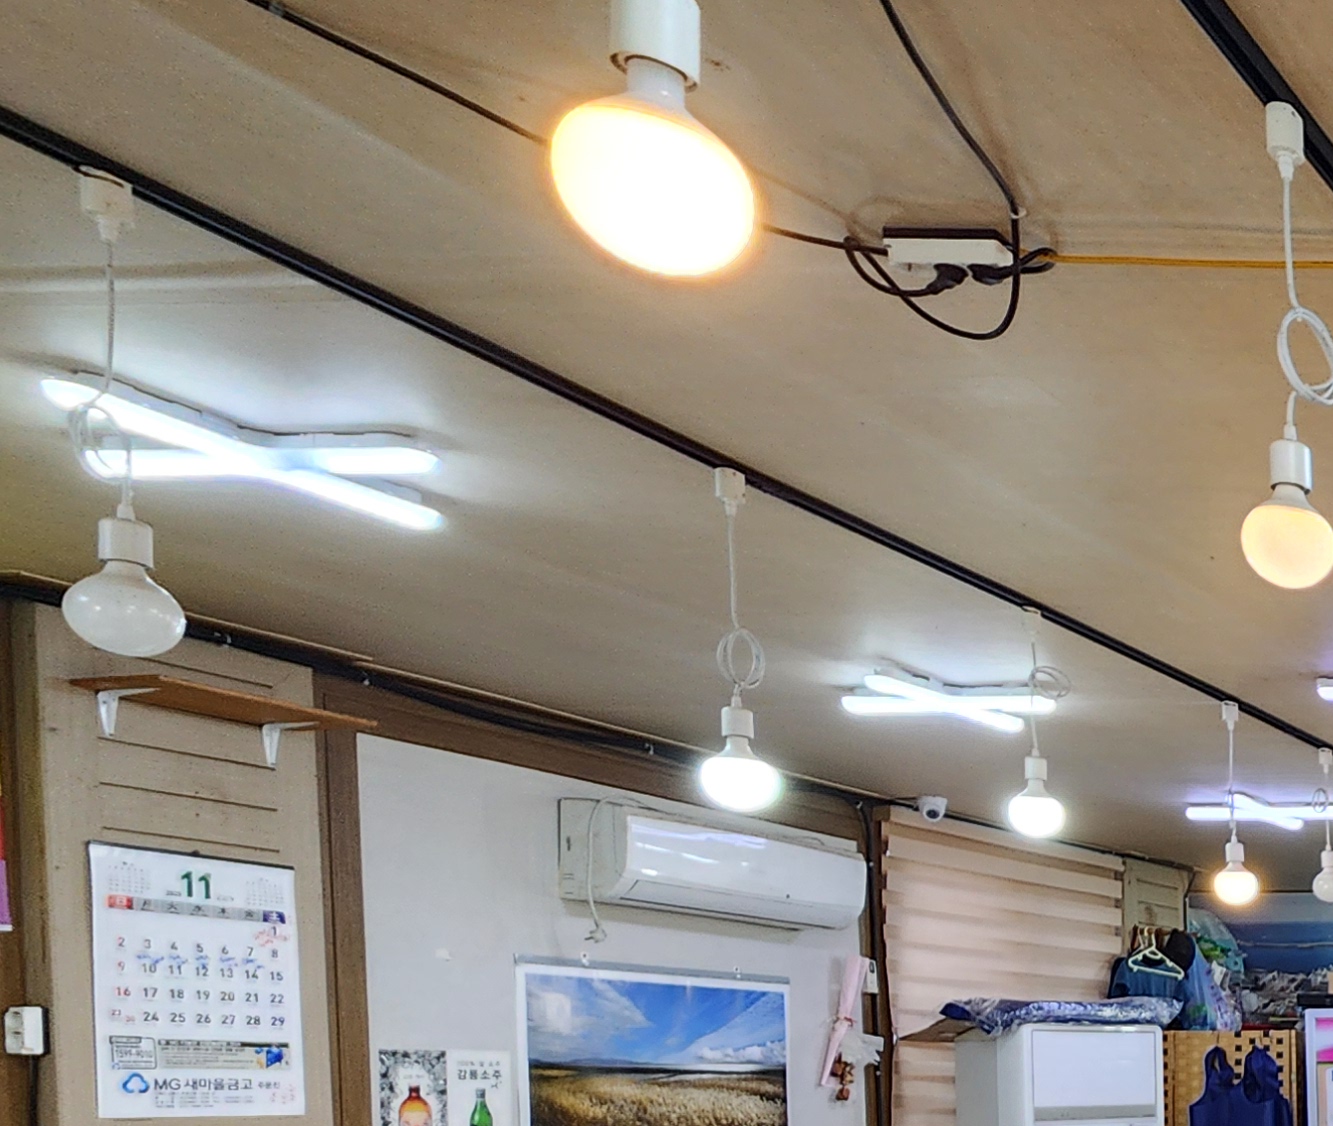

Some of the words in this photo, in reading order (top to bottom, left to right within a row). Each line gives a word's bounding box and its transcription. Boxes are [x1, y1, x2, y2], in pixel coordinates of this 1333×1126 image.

[181, 871, 211, 899] 11
[143, 939, 151, 948] 3
[171, 942, 178, 950] 4
[222, 946, 229, 955] 6
[271, 950, 278, 958] 8
[142, 963, 157, 973] 10
[169, 965, 182, 975] 11
[195, 967, 209, 977] 12
[220, 968, 233, 978] 13
[245, 969, 259, 979] 14
[270, 972, 283, 981] 15
[116, 987, 131, 996] 16
[143, 988, 157, 997] 17
[170, 989, 184, 999] 18
[196, 990, 210, 1000] 19
[220, 992, 234, 1001] 20
[245, 993, 258, 1002] 21
[270, 994, 284, 1003] 22
[143, 1012, 159, 1022] 24
[170, 1013, 185, 1023] 25
[196, 1014, 211, 1024] 26
[221, 1015, 236, 1025] 27
[246, 1016, 260, 1026] 28
[271, 1017, 285, 1026] 29
[184, 1078, 253, 1091] 새마을금고
